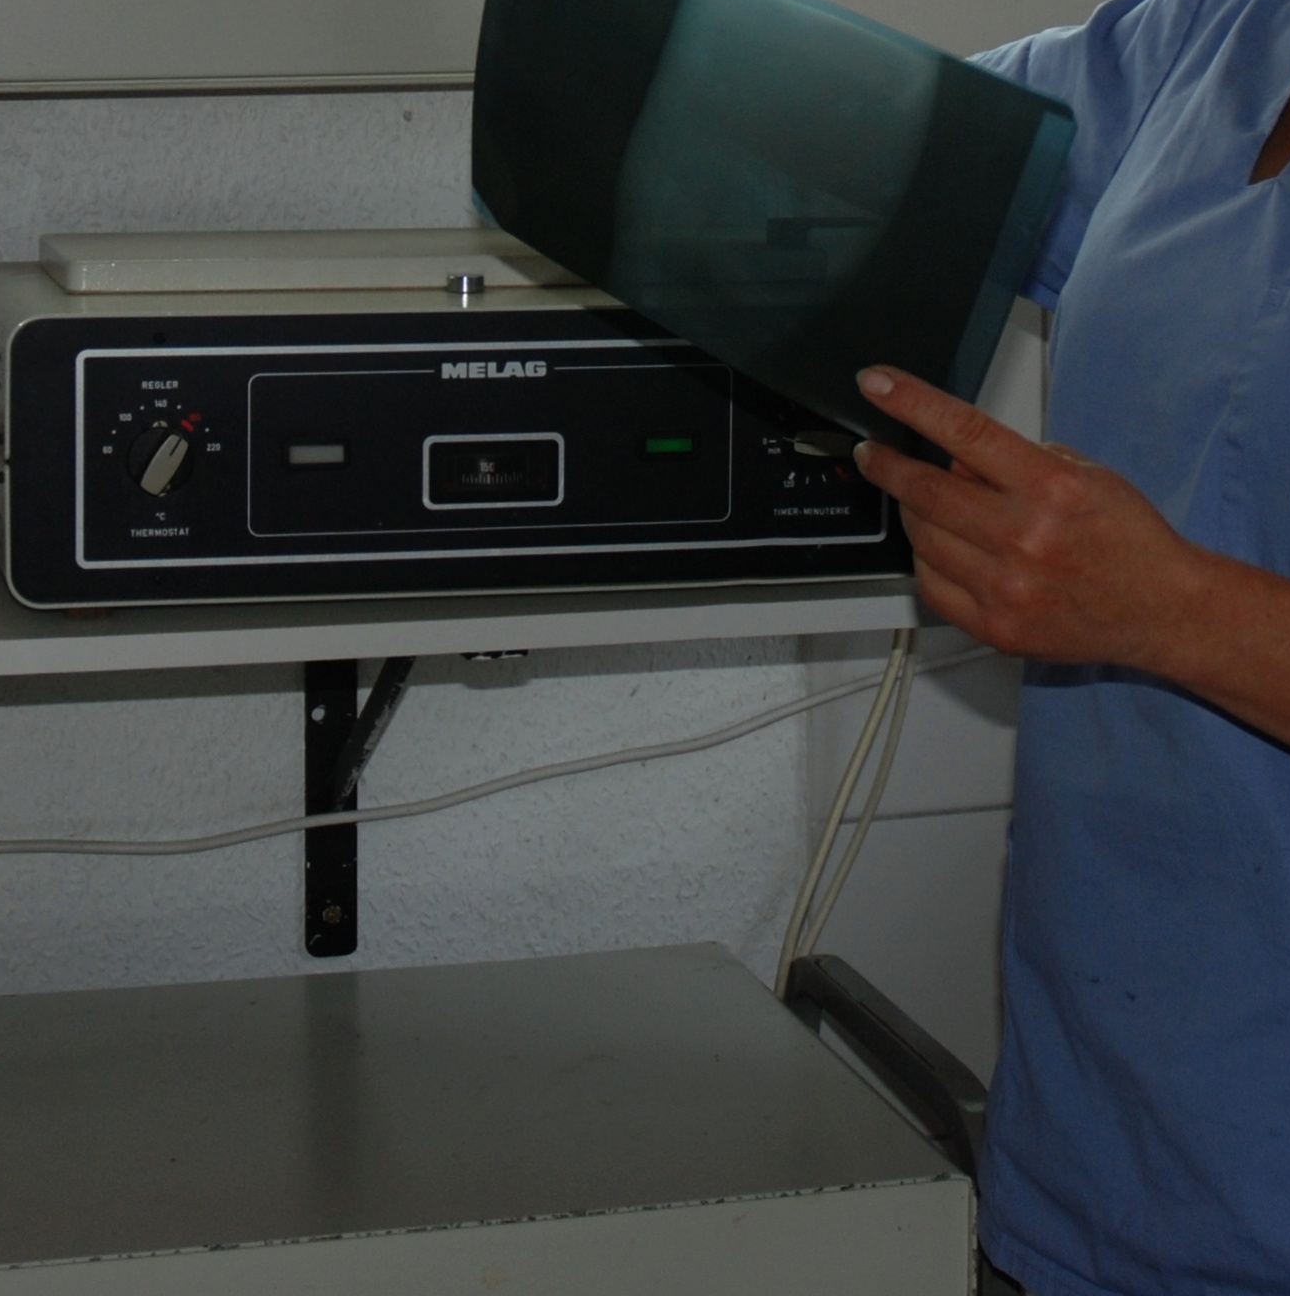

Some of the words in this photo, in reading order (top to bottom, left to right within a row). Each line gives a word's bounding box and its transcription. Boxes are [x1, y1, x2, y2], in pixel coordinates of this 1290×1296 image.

[440, 360, 547, 379] MELAG
[141, 380, 179, 390] REGLER
[206, 443, 221, 452] 220
[130, 527, 190, 538] THERMOSTAT
